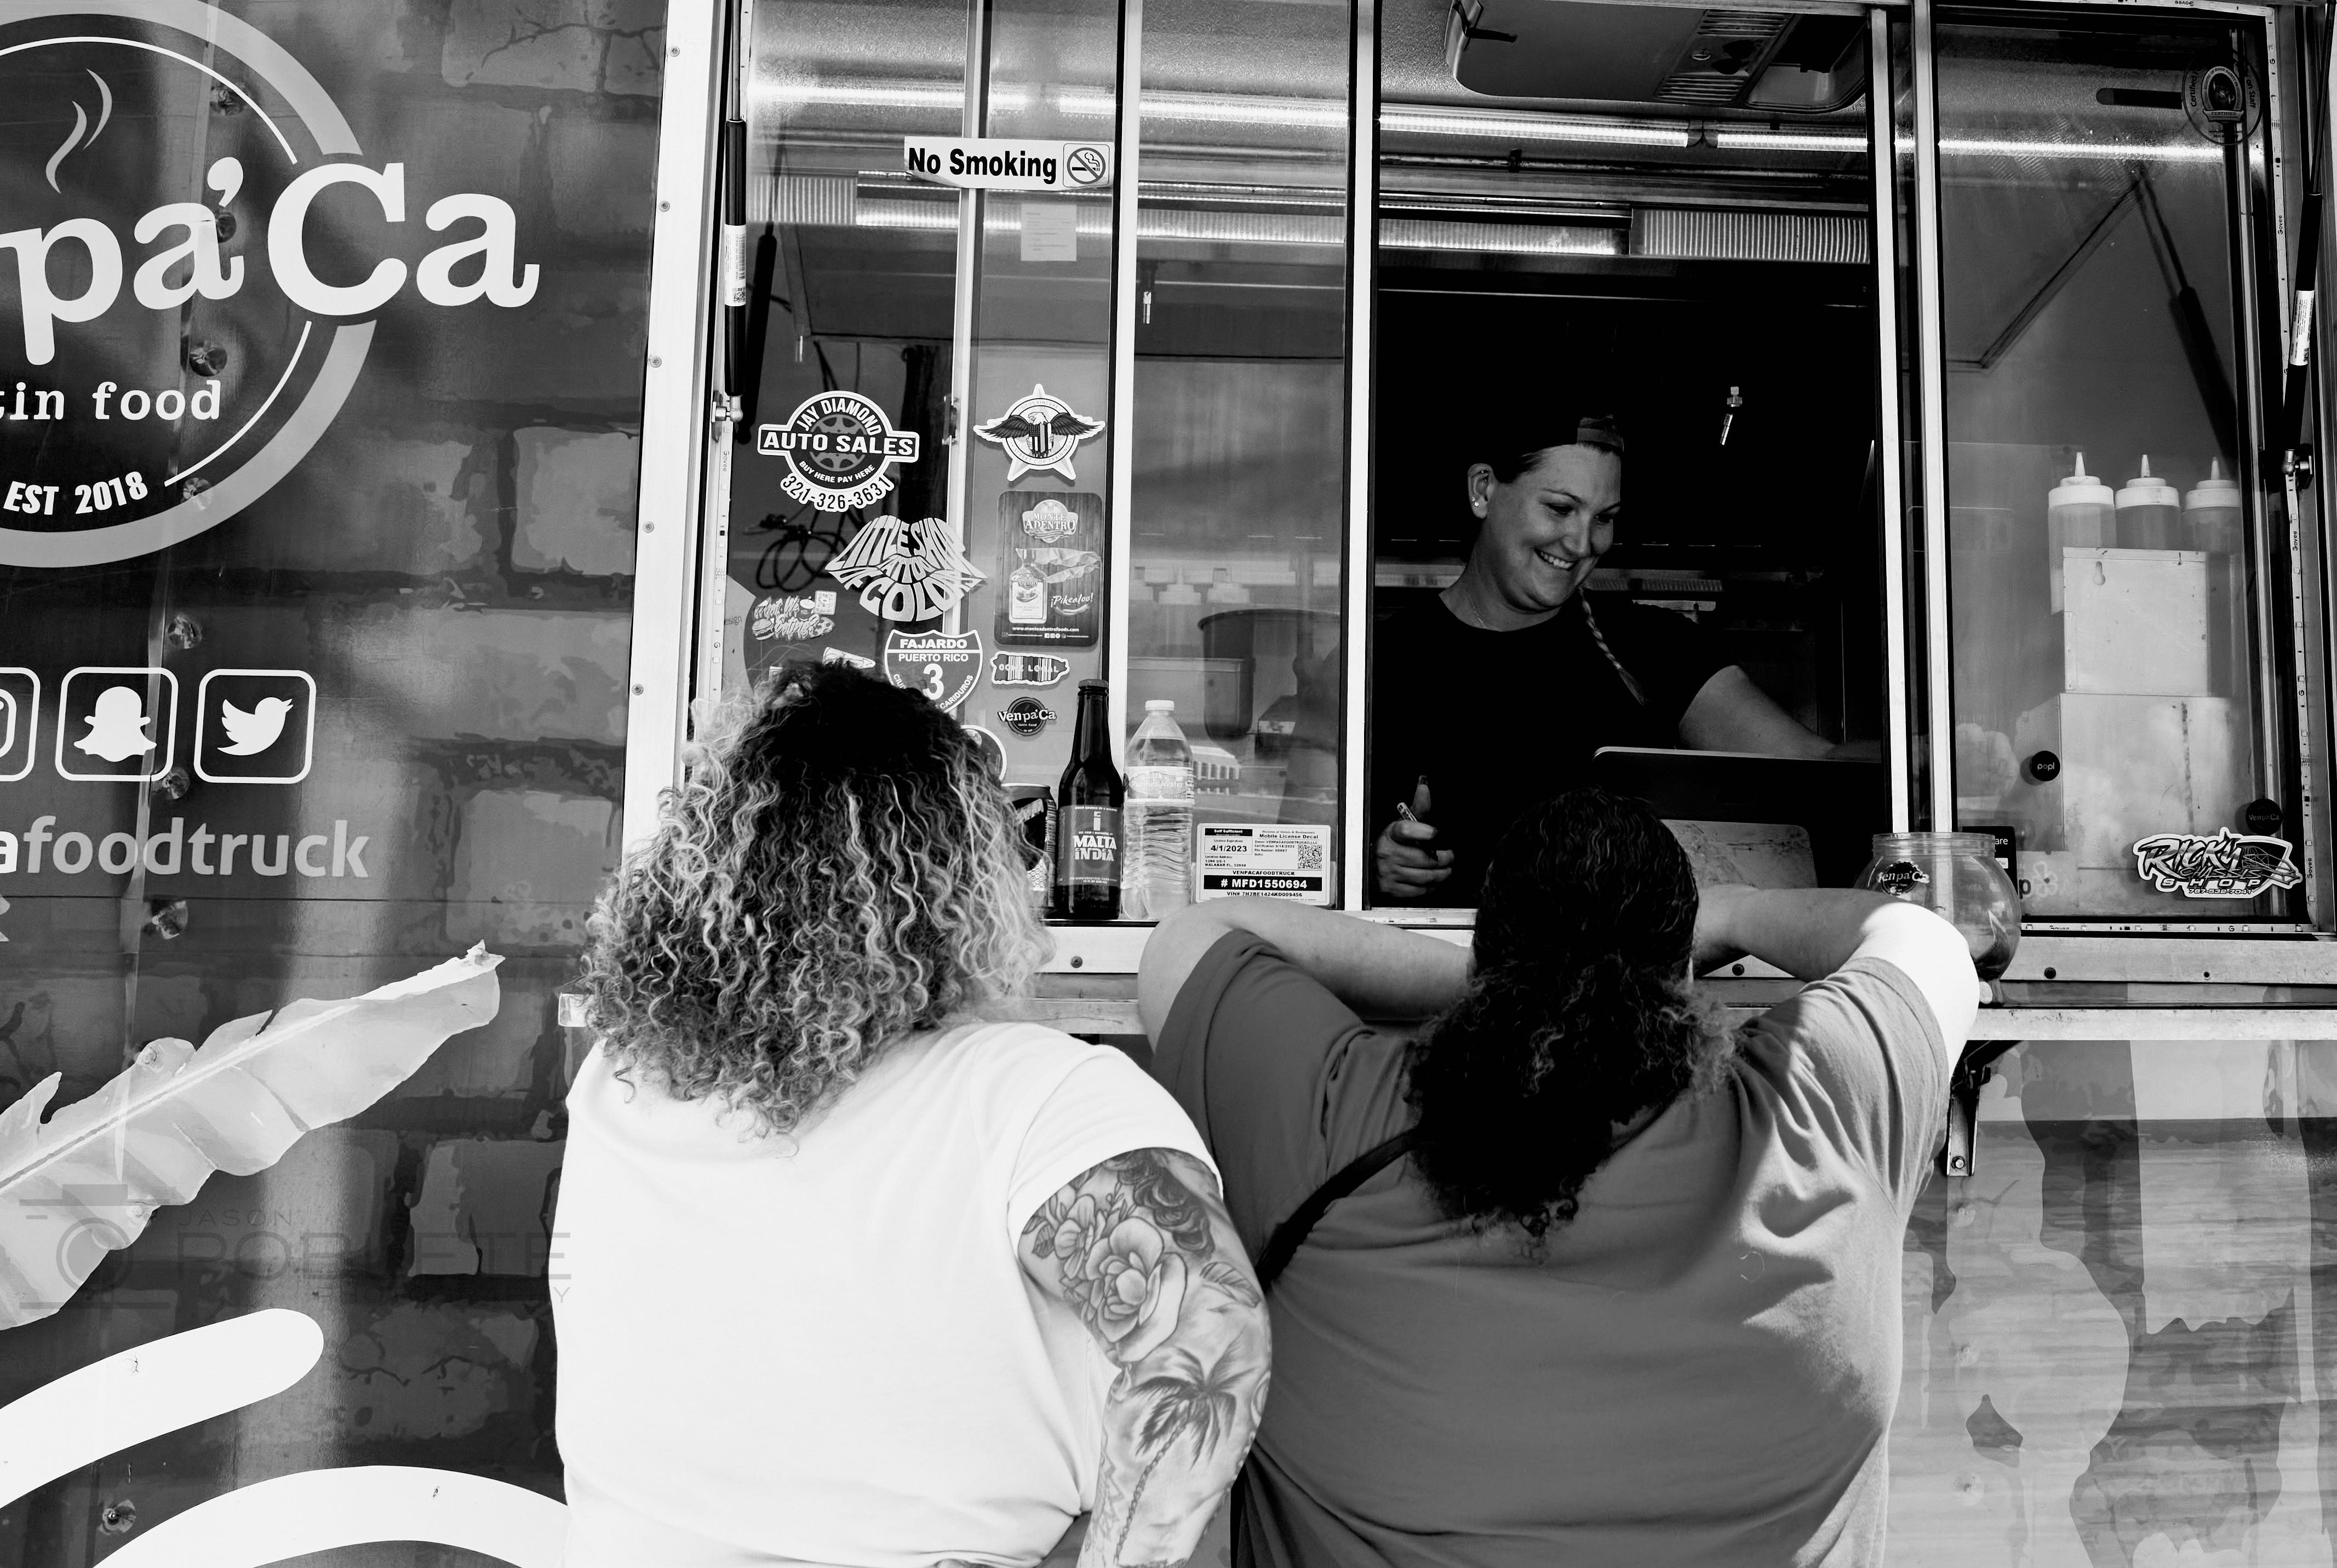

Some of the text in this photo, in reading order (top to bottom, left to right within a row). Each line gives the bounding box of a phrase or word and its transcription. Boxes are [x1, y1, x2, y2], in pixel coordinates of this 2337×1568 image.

[908, 147, 1057, 185] No Smoking
[92, 380, 221, 420] food
[797, 398, 883, 436] JAY DIAMOND
[763, 432, 913, 455] AUTO SALES
[799, 461, 815, 475] BUY
[814, 472, 836, 483] HERE
[855, 464, 875, 480] HERE
[3, 470, 148, 515] EST 2018
[783, 474, 891, 509] 321-326-3631
[1025, 518, 1076, 530] ADENTRO
[1033, 512, 1067, 521] MONTE
[900, 639, 967, 649] FAJARDO
[898, 653, 969, 662] PUERTO RICO
[923, 663, 944, 700] 3
[2037, 762, 2055, 772] popl
[1073, 835, 1117, 850] MALTA
[2179, 866, 2262, 880] CHASSIS
[1221, 878, 1308, 889] # MFD1550694
